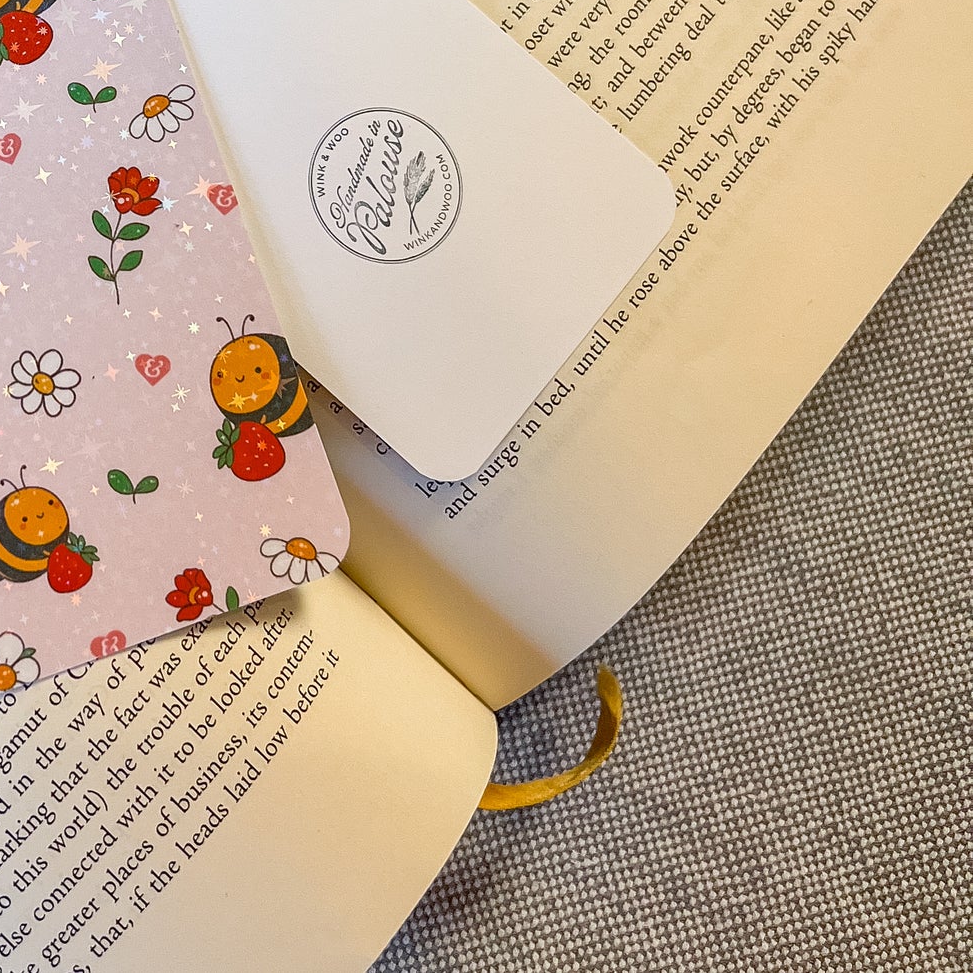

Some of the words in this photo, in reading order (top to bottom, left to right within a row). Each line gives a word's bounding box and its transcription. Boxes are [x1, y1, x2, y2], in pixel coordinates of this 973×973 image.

[695, 33, 775, 127] counterpane,
[764, 1, 797, 32] like
[720, 135, 771, 193] surface,
[765, 92, 801, 130] with
[791, 65, 821, 93] his
[818, 21, 857, 67] spiky
[315, 164, 327, 198] WINK
[321, 154, 330, 162] &
[325, 127, 349, 151] WOO
[329, 136, 374, 229] Handmade
[367, 119, 381, 137] in
[346, 119, 404, 255] Palouse
[403, 153, 453, 251] WINKANDWOO.COM
[41, 897, 101, 969] greater
[101, 839, 155, 904] places
[155, 804, 177, 838] of
[169, 734, 249, 814] business,
[241, 701, 268, 730] its
